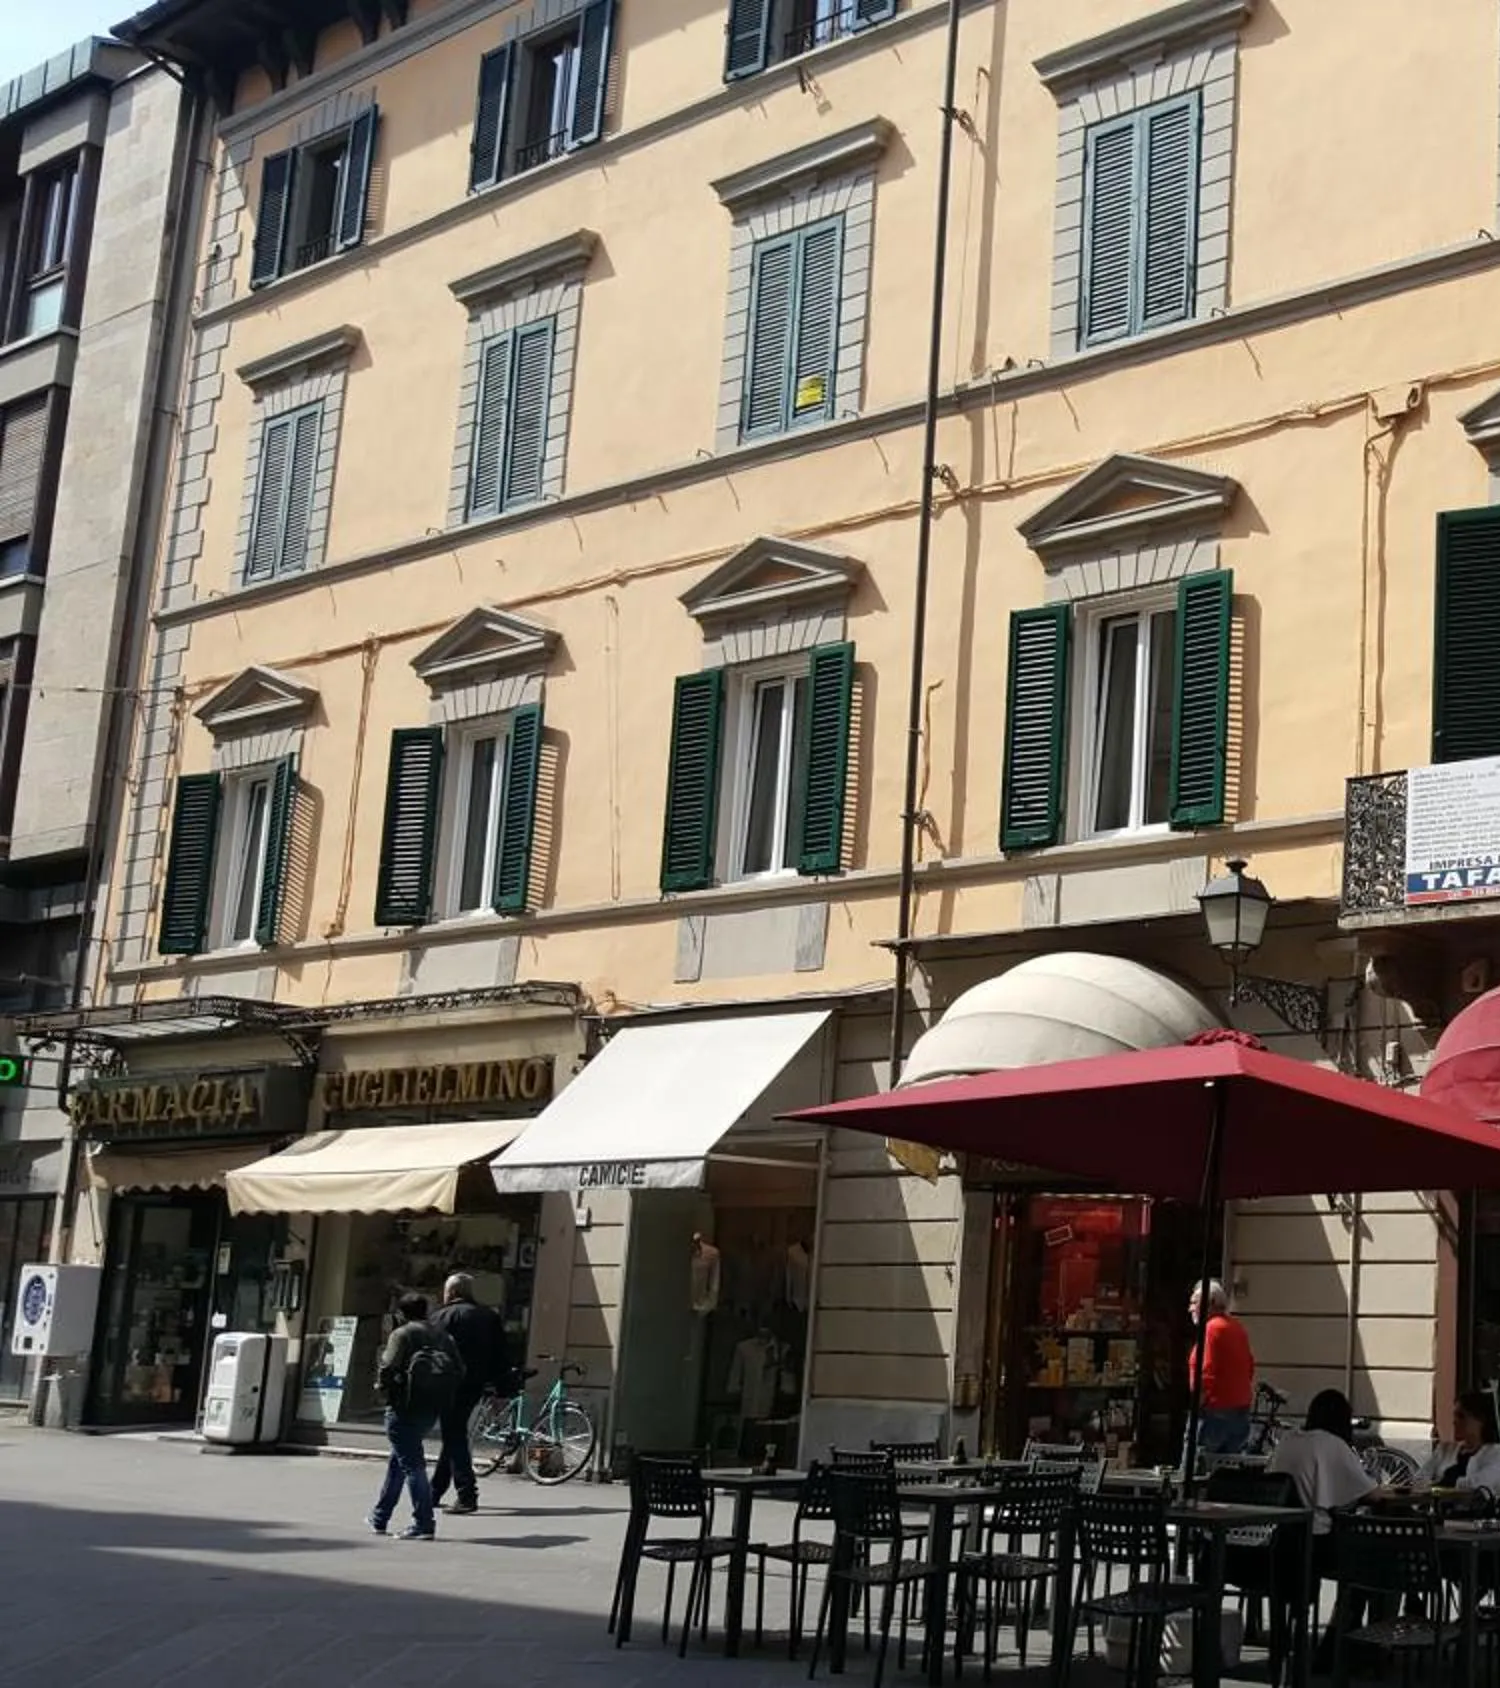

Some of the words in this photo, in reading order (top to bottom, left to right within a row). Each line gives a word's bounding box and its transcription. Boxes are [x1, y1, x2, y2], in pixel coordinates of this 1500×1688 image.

[1430, 855, 1493, 870] IMPRESA
[70, 1077, 256, 1126] FARMACIA
[322, 1057, 546, 1111] GUGLIELMINO
